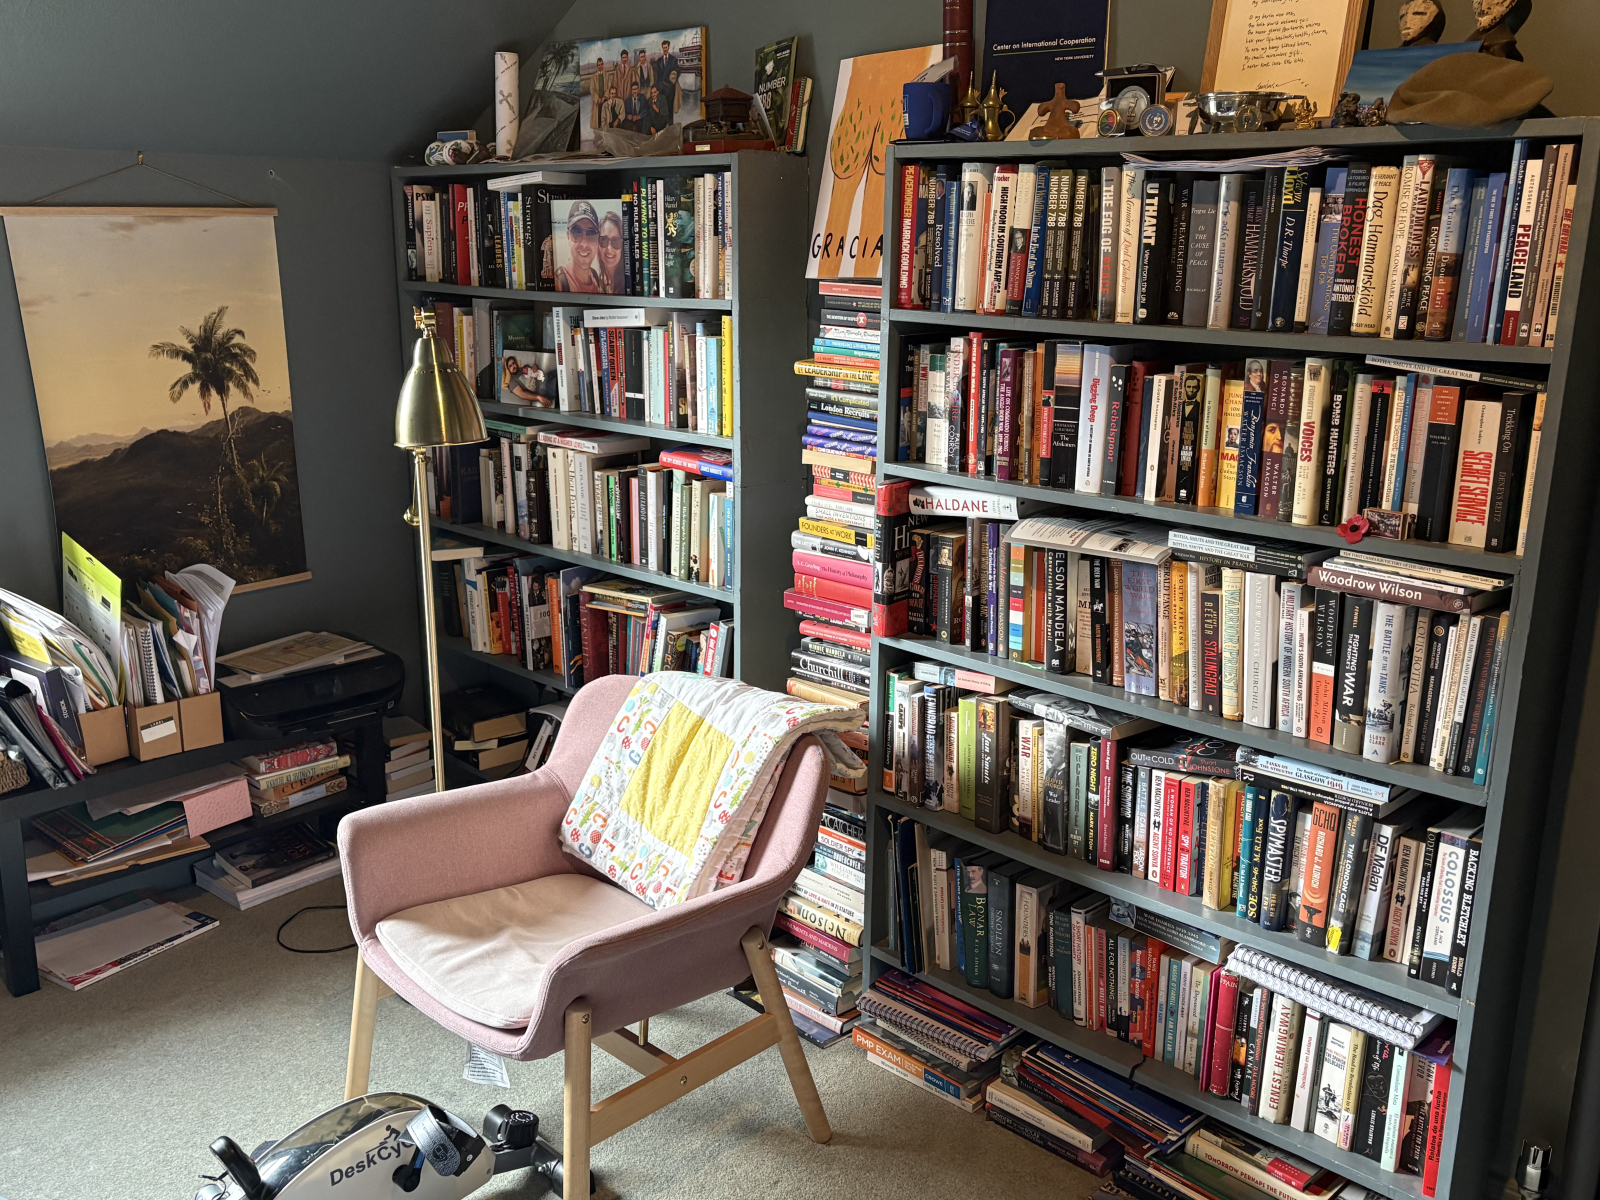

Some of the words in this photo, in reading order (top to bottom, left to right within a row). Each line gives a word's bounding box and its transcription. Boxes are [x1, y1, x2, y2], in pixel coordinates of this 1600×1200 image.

[1022, 39, 1058, 48] International
[1059, 37, 1096, 45] Cooperation
[759, 77, 786, 93] NUMBER
[632, 194, 638, 204] NO
[903, 166, 914, 217] PEACEMONGER
[1048, 176, 1059, 209] NUMBER
[1058, 176, 1069, 209] NUMBER
[1075, 176, 1086, 209] NUMBER
[1103, 185, 1114, 207] THE
[1147, 183, 1159, 194] U
[1450, 184, 1460, 200] The
[640, 188, 648, 223] PLAYING
[1047, 212, 1056, 227] 788
[1057, 212, 1066, 227] 788
[1073, 212, 1083, 228] 788
[1365, 191, 1388, 218] Dag
[1409, 180, 1430, 258] LANDMINES
[641, 227, 648, 238] TO
[901, 219, 911, 253] MARRACK
[1101, 211, 1113, 235] FOG
[1143, 197, 1159, 246] THANT
[1284, 216, 1296, 239] D.R.
[1349, 198, 1367, 266] HONEST
[1442, 205, 1459, 252] Translator
[494, 236, 503, 269] LEADERS
[641, 241, 649, 260] WIN
[934, 224, 944, 267] Resolved
[1101, 238, 1111, 253] OF
[1279, 240, 1293, 268] Thorpe
[1335, 205, 1354, 274] BROKER
[1424, 226, 1439, 282] ENGINEERING
[649, 241, 658, 280] JUDGMENT
[899, 254, 910, 288] GOULDING
[1100, 256, 1110, 295] PEACE
[1356, 224, 1383, 317] Hammarskjöld
[1439, 255, 1450, 285] Daoud
[1508, 224, 1532, 299] PEACELAND
[1140, 294, 1147, 304] UN
[1420, 285, 1431, 311] PEACE
[1434, 288, 1445, 308] Hari
[805, 362, 843, 378] LEADERSHIP
[1274, 374, 1279, 383] DA
[840, 395, 870, 407] Complicated
[1089, 378, 1100, 404] Digging
[1279, 371, 1288, 415] LEONARDO
[821, 402, 848, 415] London
[849, 407, 870, 419] Recruits
[1088, 405, 1097, 423] Deep
[1333, 394, 1343, 426] BOMB
[1502, 409, 1516, 440] Trekking
[1107, 401, 1121, 462] Rebelspoor
[1502, 441, 1511, 453] On
[1326, 428, 1338, 475] HUNTERS
[1263, 459, 1272, 498] ISAACSON
[1271, 463, 1280, 495] WALTER
[1460, 450, 1494, 486] SECRET
[815, 507, 831, 516] SMALL
[833, 510, 866, 522] INVENTIONS
[924, 498, 989, 513] HALDANE
[1455, 486, 1489, 526] SERVICE
[801, 521, 829, 534] FOUNDERS
[835, 530, 853, 541] WORK
[828, 566, 841, 575] History
[845, 570, 868, 582] Philosophy
[1318, 570, 1375, 592] Woodrow
[1377, 582, 1422, 601] Wilson
[1054, 595, 1065, 652] MANDELA
[1204, 601, 1215, 635] BEEVOR
[1224, 589, 1241, 643] WARRIOR
[1316, 604, 1325, 648] WILSON
[1326, 599, 1336, 657] WOODROW
[1385, 614, 1395, 627] THE
[809, 643, 824, 652] WINNIE
[825, 647, 845, 658] MANDELA
[1382, 629, 1393, 654] BATTLE
[1413, 620, 1427, 652] LOUIS
[1204, 640, 1218, 696] STALINGRAD
[1350, 634, 1360, 671] FIGHTING
[799, 658, 844, 681] Churchill
[1223, 648, 1238, 693] PRIEST
[1379, 672, 1388, 694] TANKS
[1409, 656, 1422, 694] BOTHA
[1251, 661, 1260, 710] CHURCHILL
[1342, 672, 1356, 706] WAR
[982, 733, 992, 752] Jan
[983, 754, 992, 785] Smuts
[1089, 771, 1097, 792] NIGHT
[1312, 807, 1337, 832] GCHQ
[820, 835, 845, 849] SOLDIER
[845, 843, 857, 852] SPY
[1181, 835, 1190, 848] SPY
[1264, 817, 1287, 883] SPYMASTER
[1376, 834, 1390, 857] DF
[1402, 844, 1412, 857] BEN
[1424, 834, 1436, 867] ODETTE
[1179, 853, 1189, 879] TRAITOR
[1367, 857, 1387, 893] Malan
[1397, 858, 1410, 892] MACINTYRE
[1462, 848, 1479, 891] BACKING
[1438, 850, 1460, 923] COLOSSUS
[800, 908, 847, 940] Nelson
[968, 903, 977, 927] LAW
[975, 896, 986, 936] BONAR
[1391, 906, 1403, 926] AGENT
[1456, 892, 1472, 947] BLETCHLEY
[1389, 927, 1400, 947] SONYA
[856, 1034, 874, 1051] PMP
[876, 1045, 901, 1064] EXAM
[1274, 1004, 1291, 1069] HEMINGWAY
[1245, 1043, 1256, 1079] CANNAE
[925, 1071, 944, 1087] CROWE
[1269, 1070, 1281, 1110] ERNEST
[1204, 1152, 1239, 1173] TOMORROW
[1241, 1168, 1265, 1185] PERHAPS
[1265, 1180, 1278, 1191] THE
